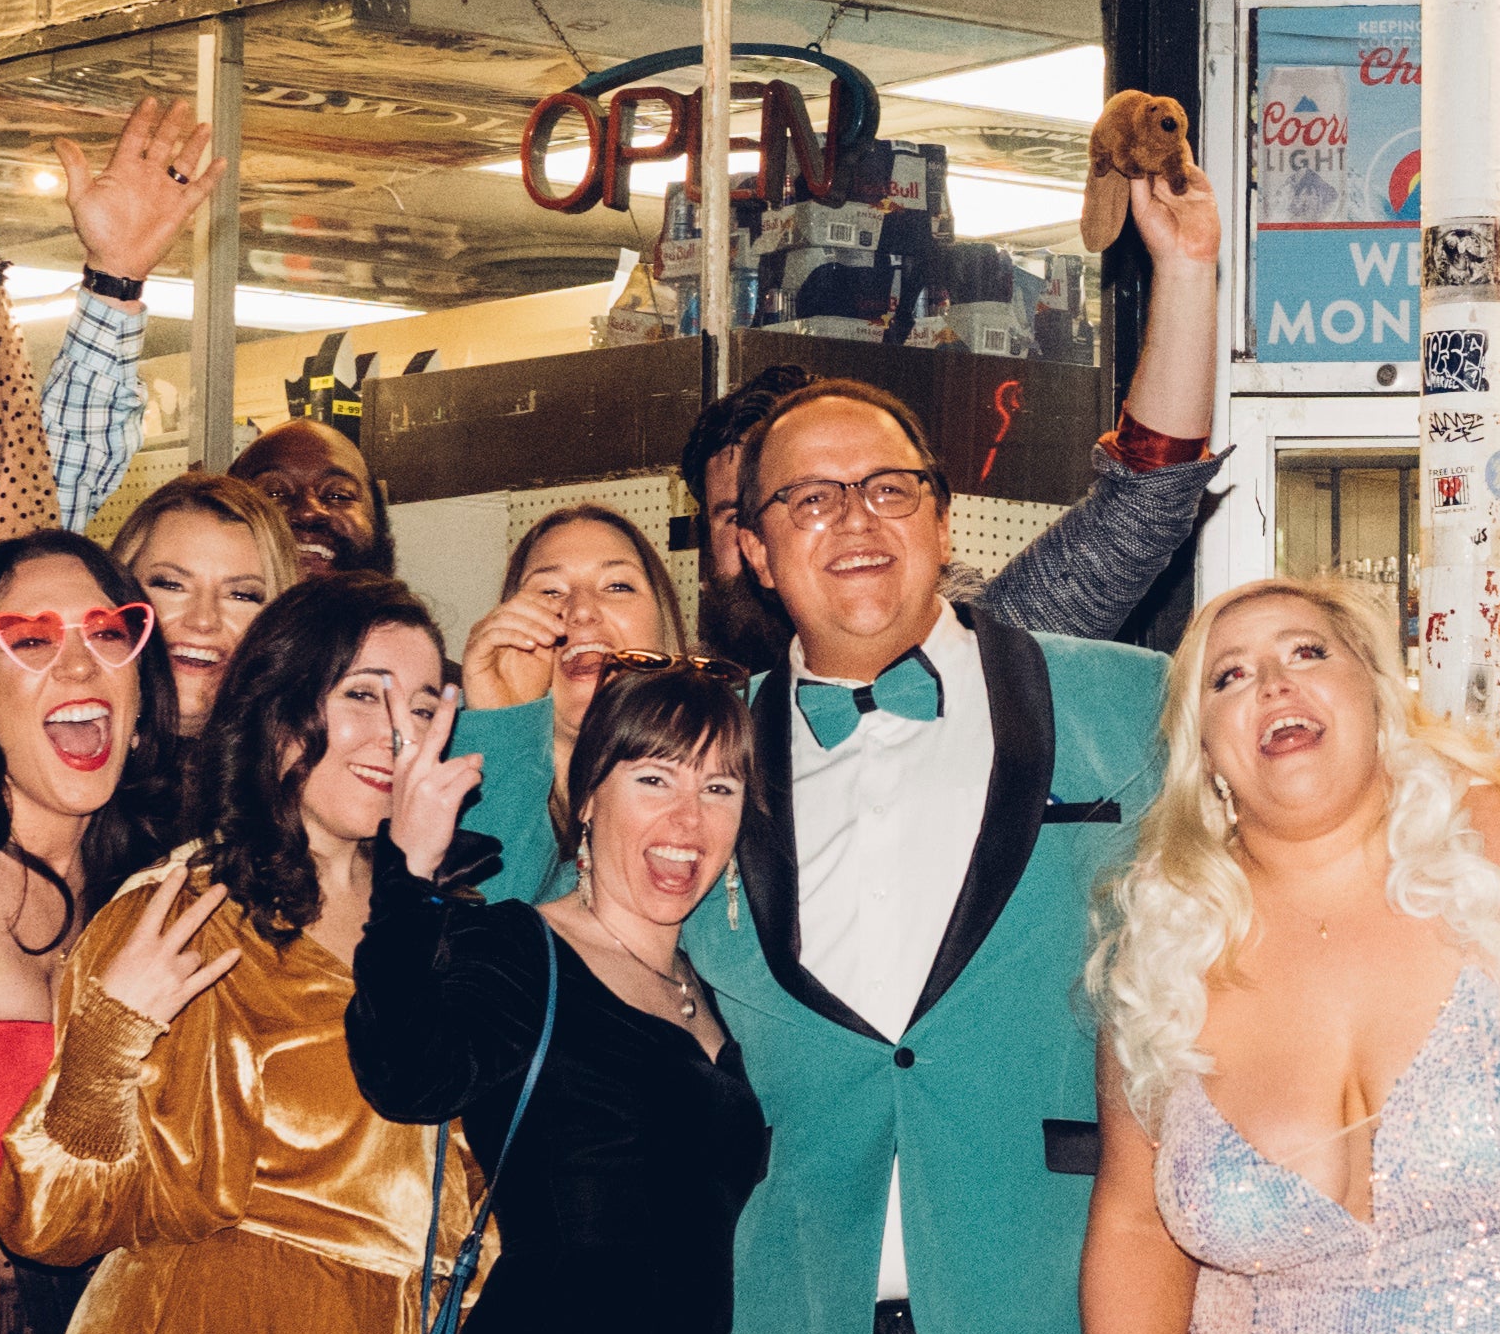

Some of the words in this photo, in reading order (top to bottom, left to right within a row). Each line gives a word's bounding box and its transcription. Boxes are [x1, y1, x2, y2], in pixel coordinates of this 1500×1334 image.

[1263, 101, 1348, 147] Coors
[521, 80, 846, 216] OPEN
[1265, 147, 1346, 172] LIGHT
[889, 180, 919, 199] Bull
[1428, 468, 1448, 477] FREE
[1451, 465, 1476, 475] LOVE
